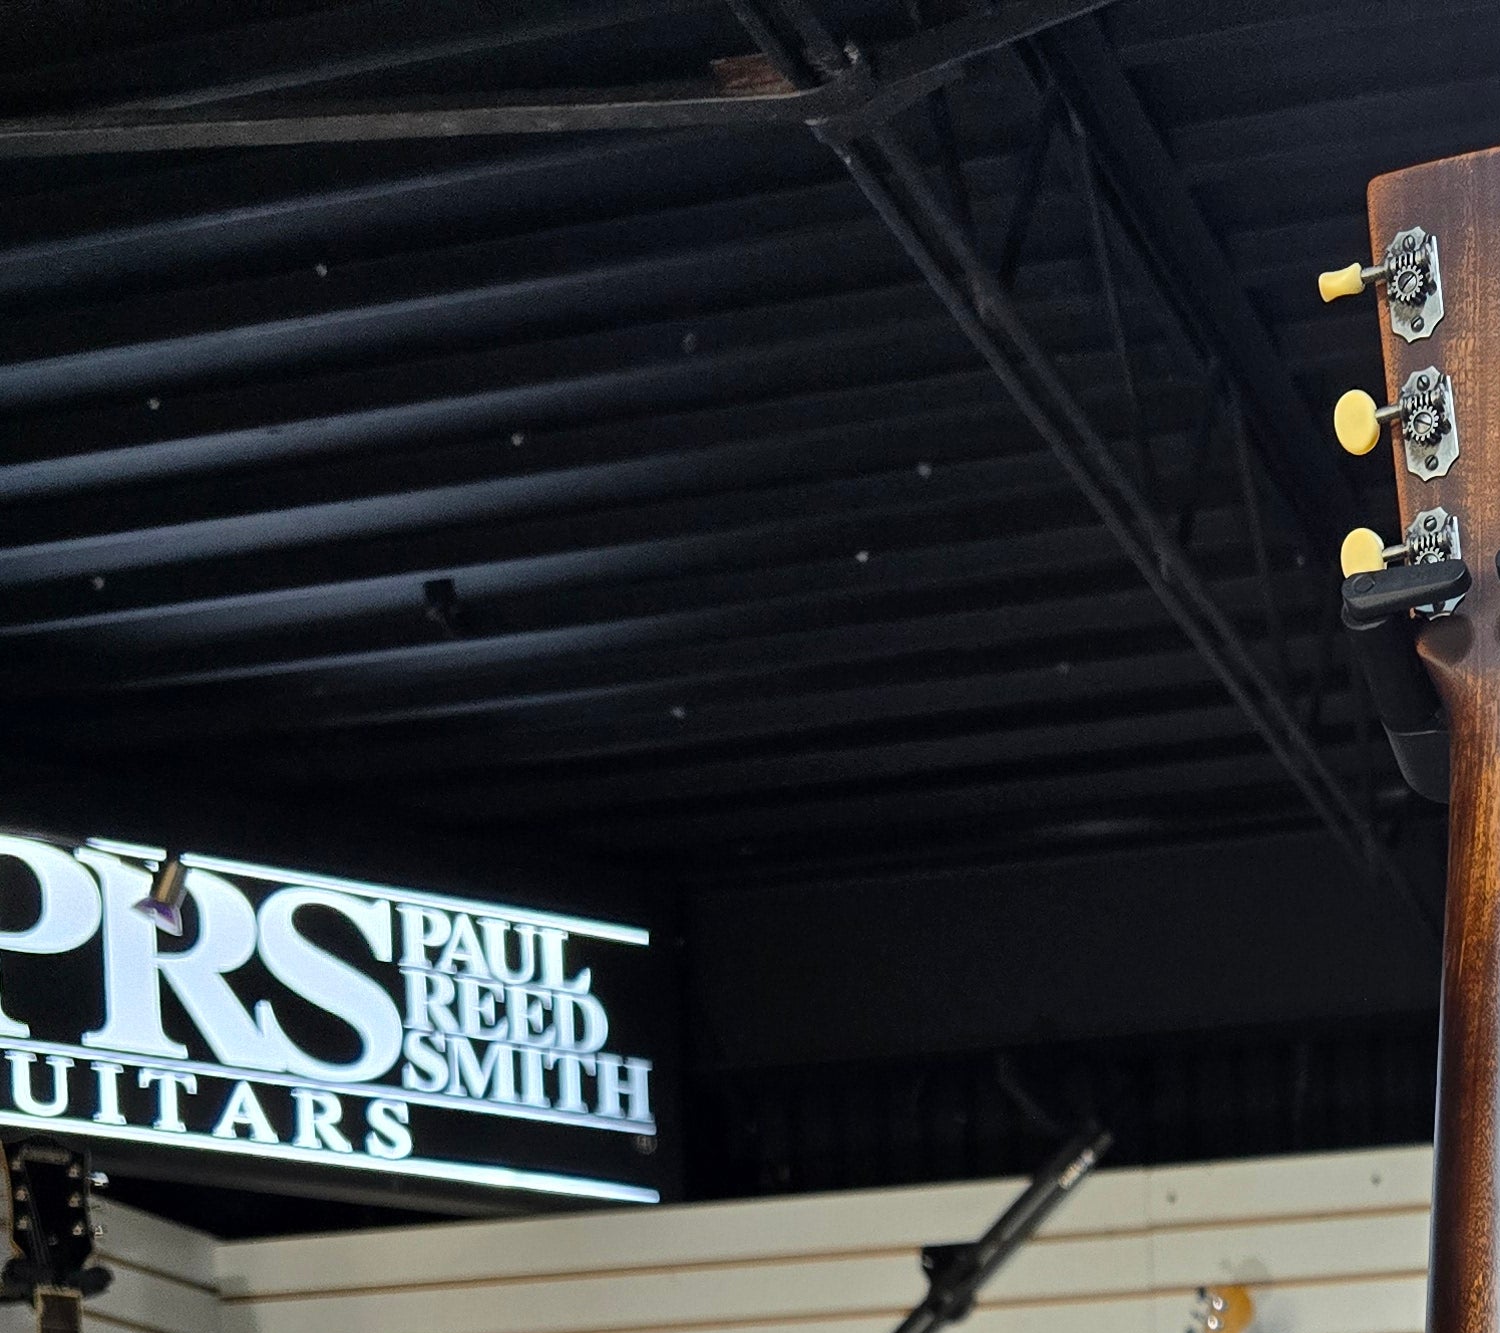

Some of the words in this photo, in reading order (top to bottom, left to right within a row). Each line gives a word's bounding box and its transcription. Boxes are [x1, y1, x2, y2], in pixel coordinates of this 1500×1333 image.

[0, 834, 401, 1083] PRS
[397, 901, 592, 996] PAUL
[401, 967, 609, 1055] REED
[4, 1049, 414, 1160] UITARS
[402, 1029, 654, 1124] SMITH
